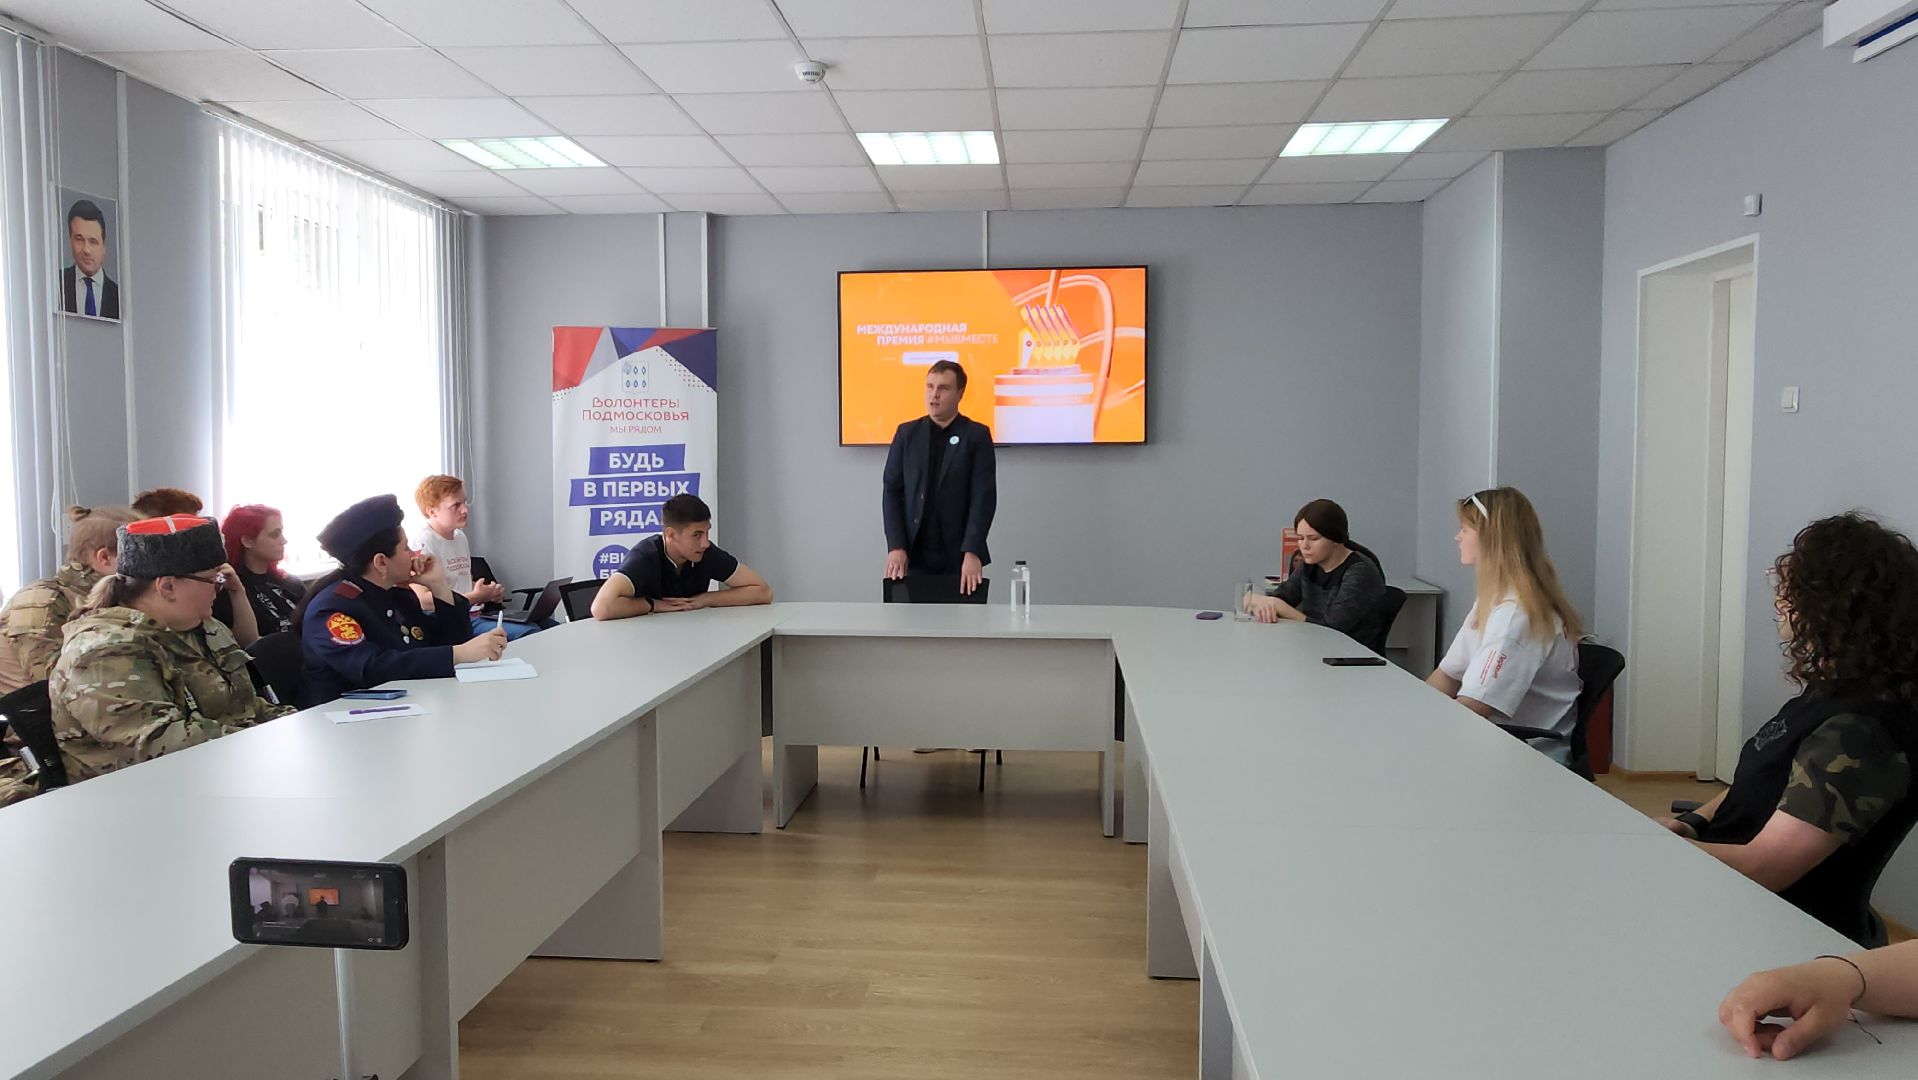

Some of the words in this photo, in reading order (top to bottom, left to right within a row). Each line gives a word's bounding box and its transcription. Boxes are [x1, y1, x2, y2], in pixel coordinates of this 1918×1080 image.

[856, 322, 967, 335] МЕЖДУНАРОДНАЯ
[876, 335, 925, 346] ПРЕМИЯ
[610, 425, 626, 433] МЫ
[628, 425, 662, 434] РЯДОМ
[609, 452, 665, 472] БУДЬ
[583, 481, 597, 498] В
[602, 480, 690, 498] ПЕРВЫХ
[600, 510, 663, 529] РЯДА
